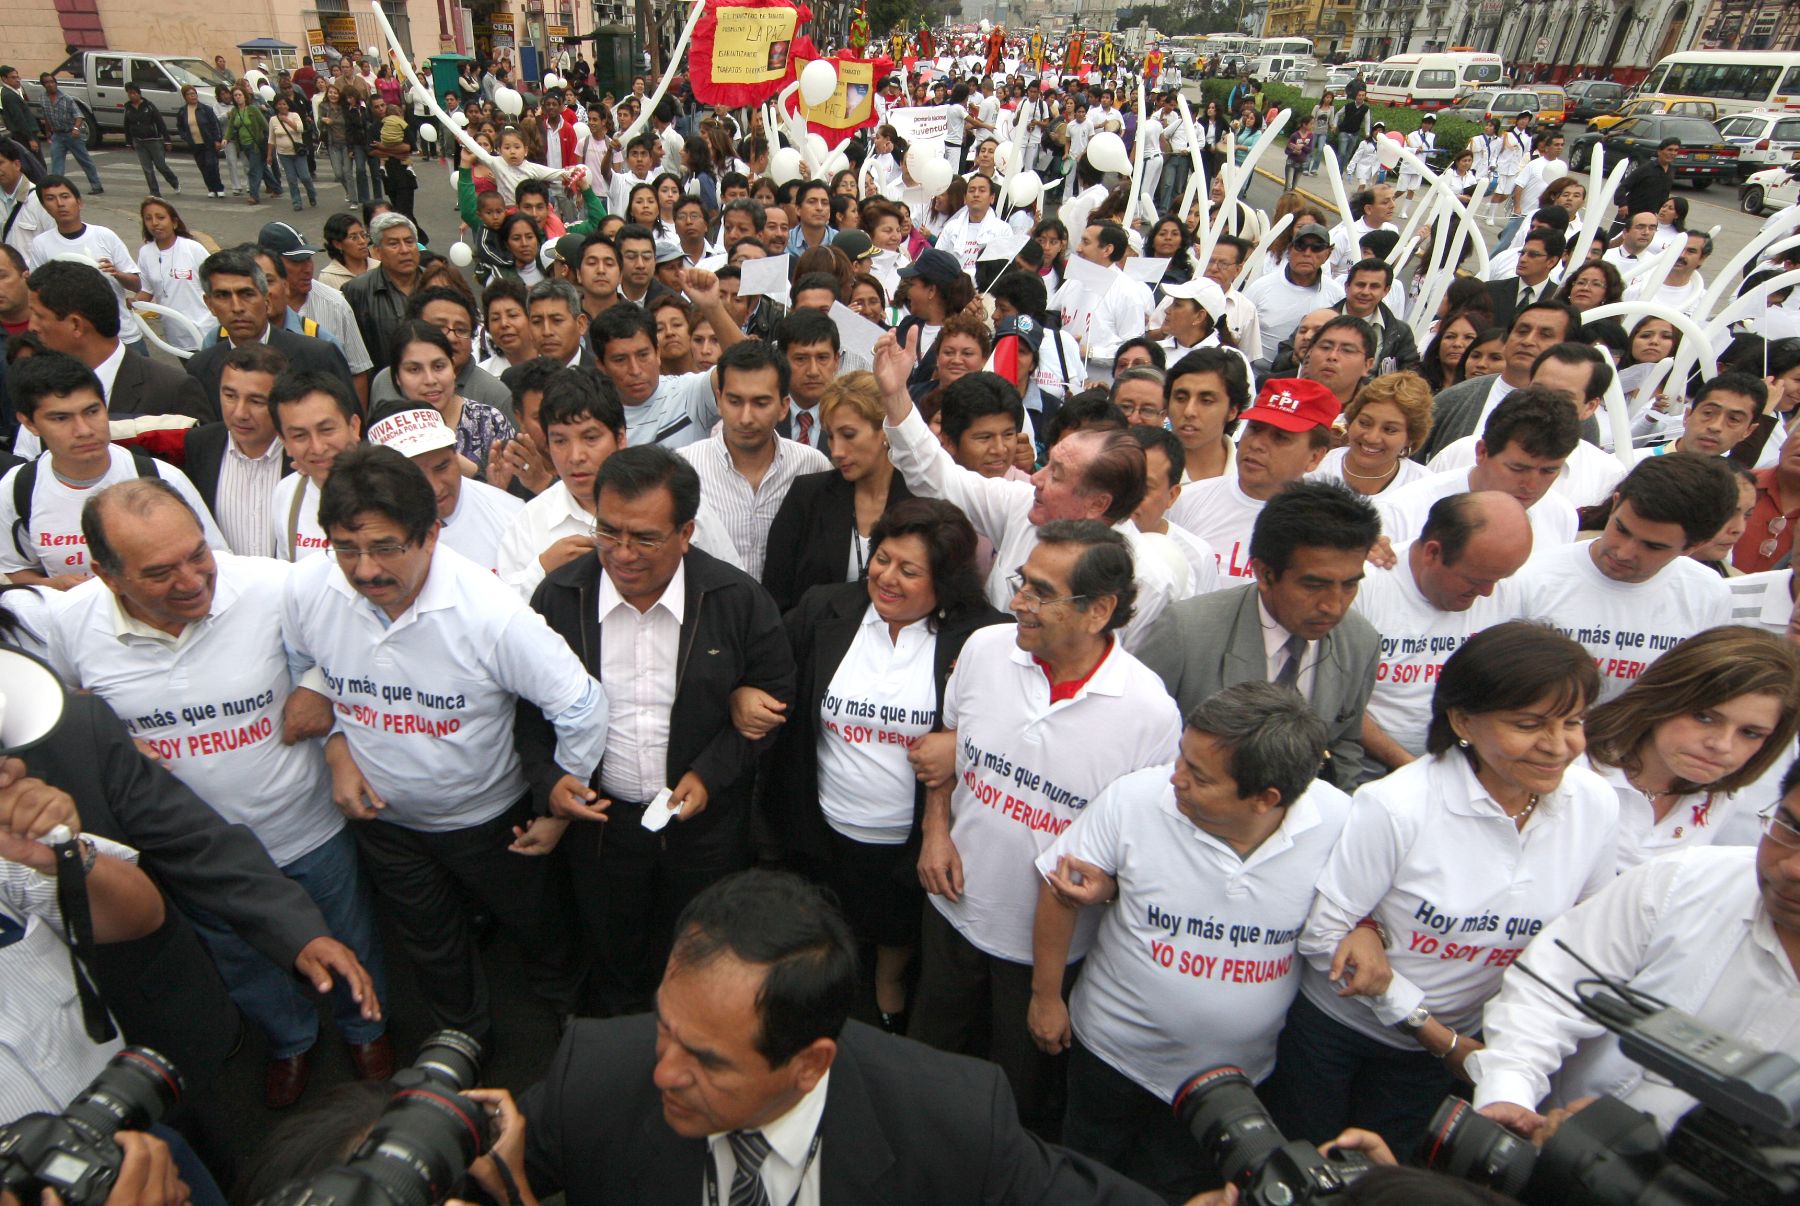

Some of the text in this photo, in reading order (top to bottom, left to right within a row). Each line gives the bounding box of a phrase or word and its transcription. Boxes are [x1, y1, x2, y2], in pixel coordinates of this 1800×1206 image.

[493, 23, 513, 31] CEBA
[746, 25, 762, 41] LA
[766, 24, 786, 41] PAZ
[911, 123, 948, 135] Juventud
[1269, 394, 1300, 410] FPI
[394, 414, 412, 428] EL
[404, 424, 418, 433] POR
[65, 551, 84, 566] el
[1229, 541, 1253, 578] LA
[1379, 634, 1455, 657] oy más que
[1578, 624, 1611, 644] más
[1615, 630, 1644, 650] que
[1376, 662, 1388, 681] O
[1391, 663, 1422, 683] SOY
[348, 675, 377, 697] más
[382, 685, 412, 705] que
[417, 691, 465, 709] nunca
[137, 709, 177, 729] más
[182, 704, 216, 726] que
[222, 689, 274, 716] nunca
[353, 704, 378, 728] SOY
[383, 714, 460, 737] PERUANO
[846, 698, 876, 718] más
[880, 705, 906, 725] que
[911, 709, 937, 725] nun
[188, 717, 272, 756] PERUANO
[844, 725, 873, 743] SOY
[878, 730, 914, 749] PERU
[964, 735, 1088, 810] Hoy más que nunca
[975, 779, 1002, 809] SOY
[1148, 904, 1182, 937] Hoy
[1187, 916, 1225, 940] más
[1229, 924, 1261, 947] que
[1414, 900, 1543, 940] Hoy más que
[1408, 931, 1438, 954] YO
[1441, 942, 1486, 962] SOY
[1151, 939, 1294, 984] YO SOY PERUANO
